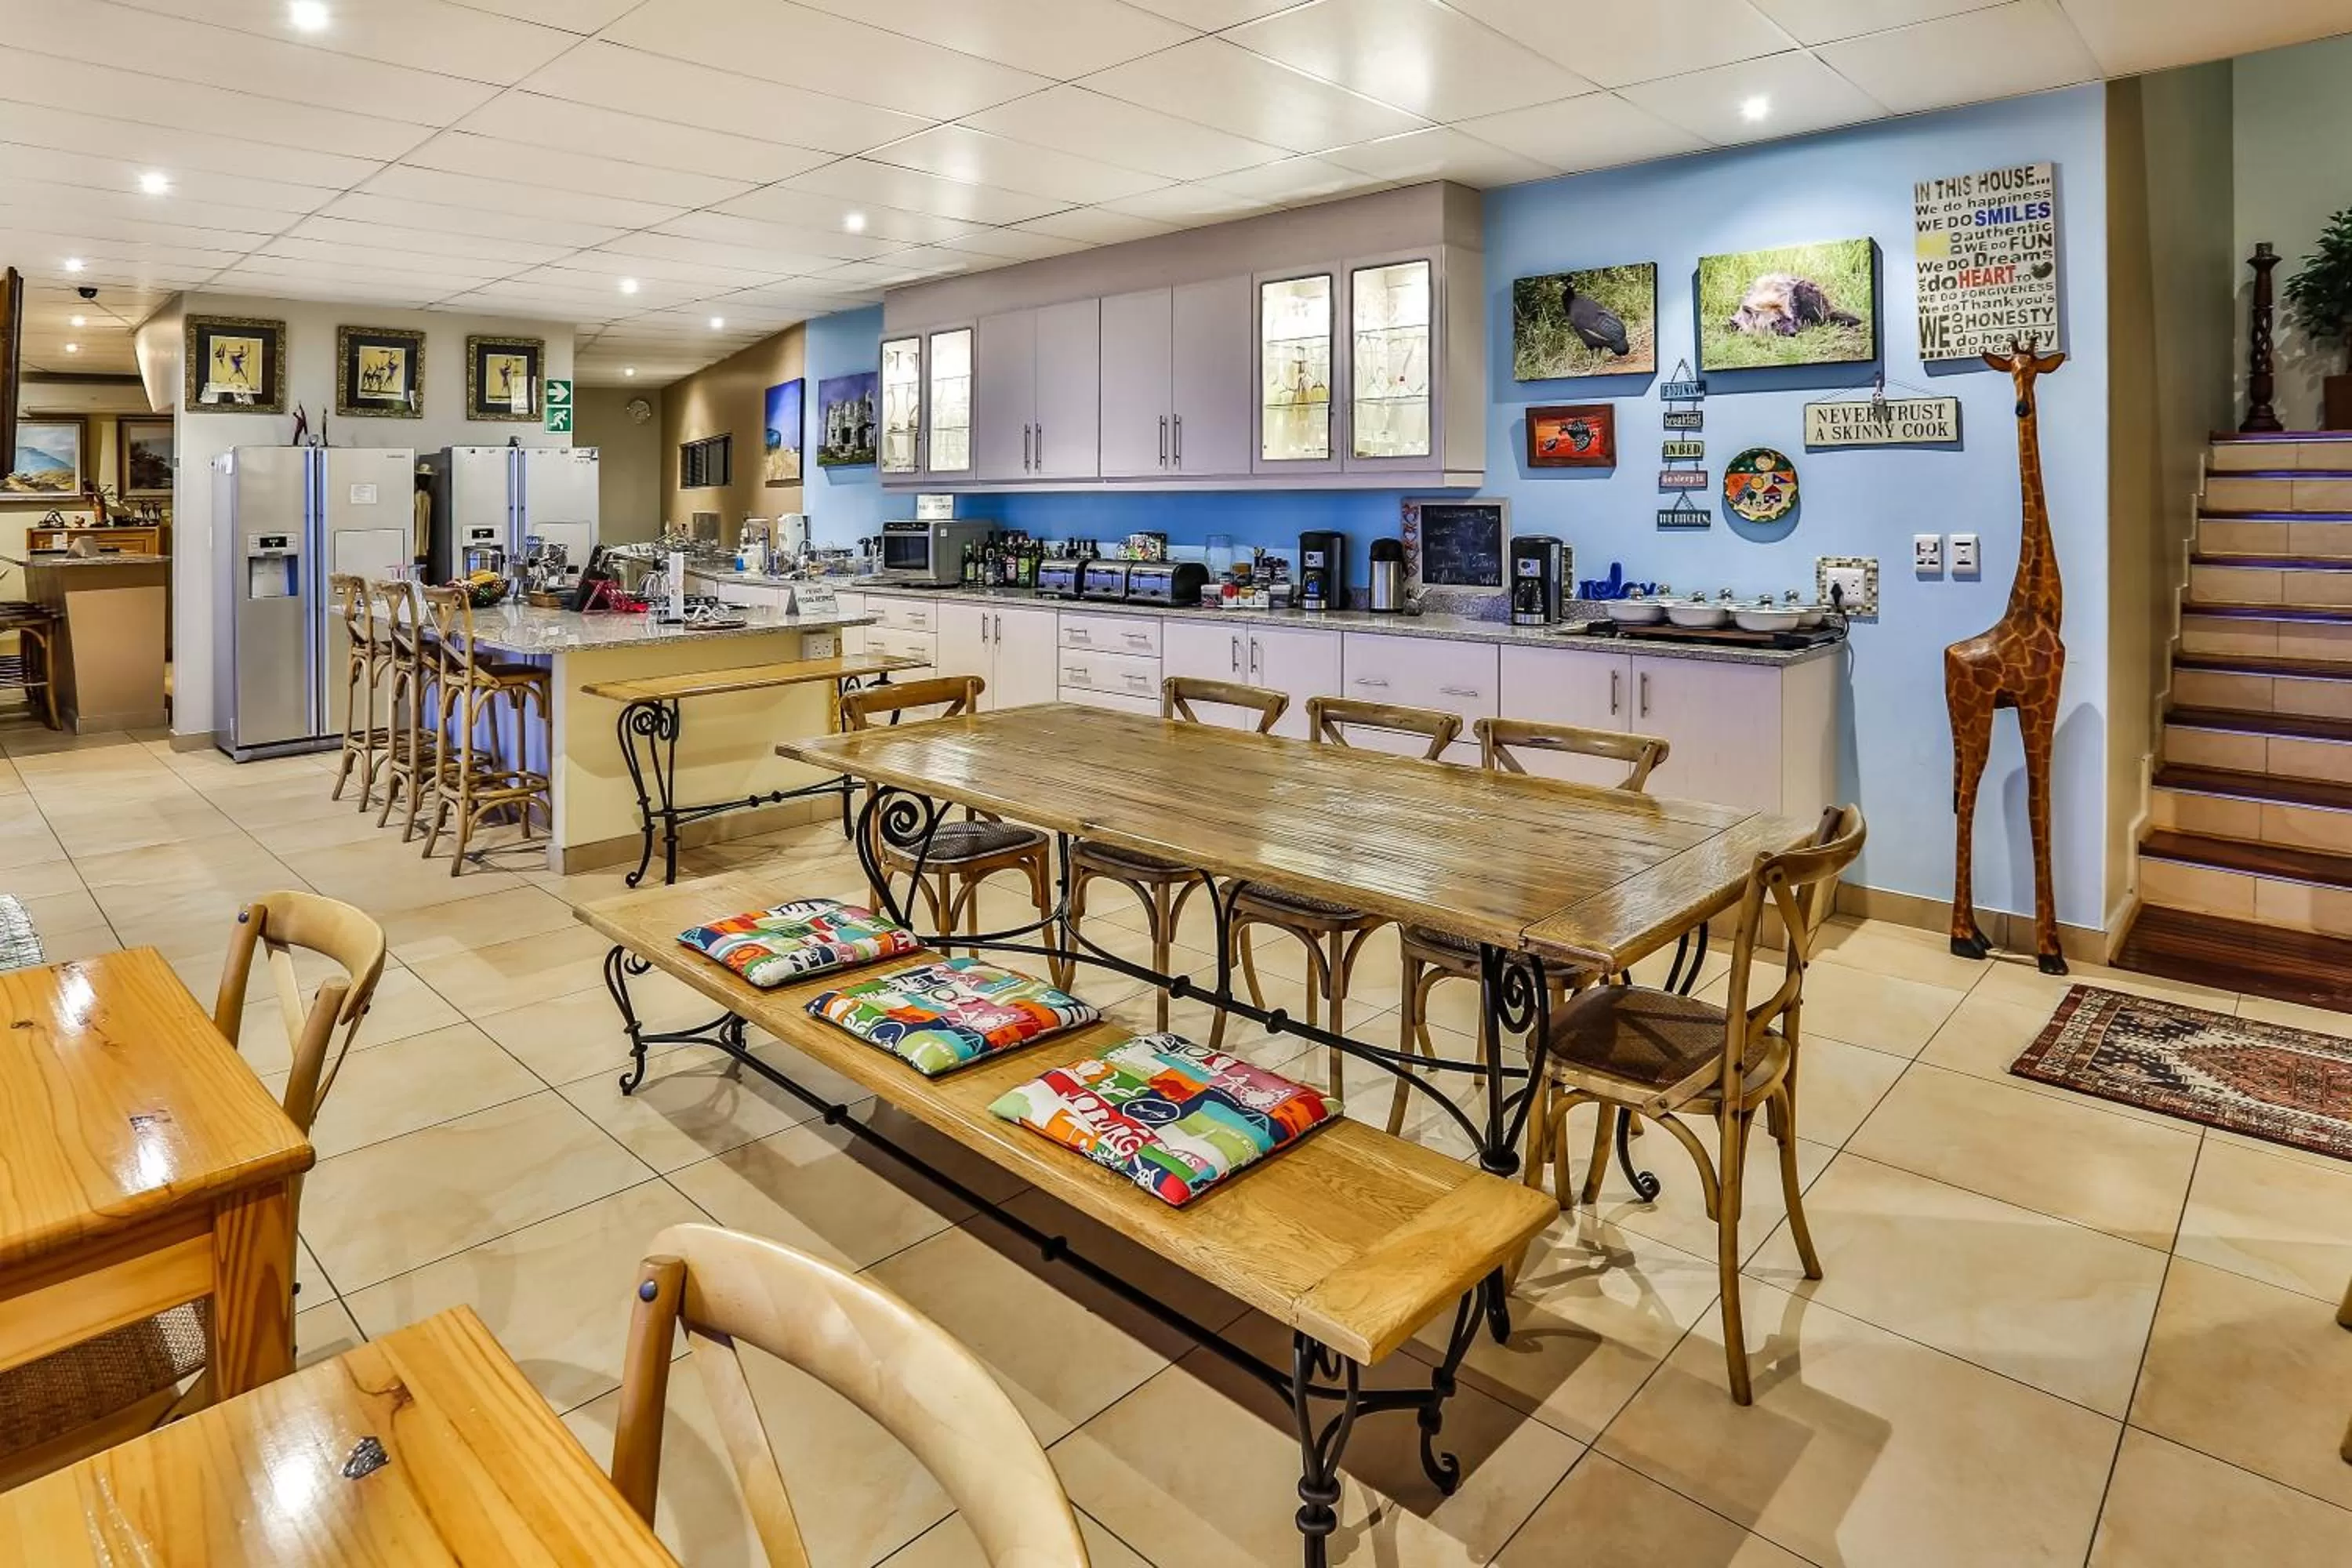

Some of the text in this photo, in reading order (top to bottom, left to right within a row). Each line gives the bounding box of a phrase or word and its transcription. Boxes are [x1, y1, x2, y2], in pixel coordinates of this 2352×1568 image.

[1915, 181, 1929, 203] IN
[1934, 175, 1971, 199] THIS
[1915, 189, 2052, 216] We do happiness
[1917, 201, 2051, 231] WE DO SMILES
[1964, 220, 2052, 241] authentic
[1965, 233, 2053, 252] WE DO FUN
[1917, 250, 2053, 274] We DO Dreams
[1928, 274, 1958, 292] do
[1958, 265, 2016, 289] HEART
[1962, 282, 2054, 298] FORGIVENESS
[1919, 314, 1951, 349] WE
[1965, 307, 2053, 328] HONESTY
[1956, 335, 1978, 347] do
[1817, 403, 1946, 424] NEVER TRUST
[1815, 422, 1949, 441] A SKINNY COOK
[1665, 444, 1700, 455] IN BED
